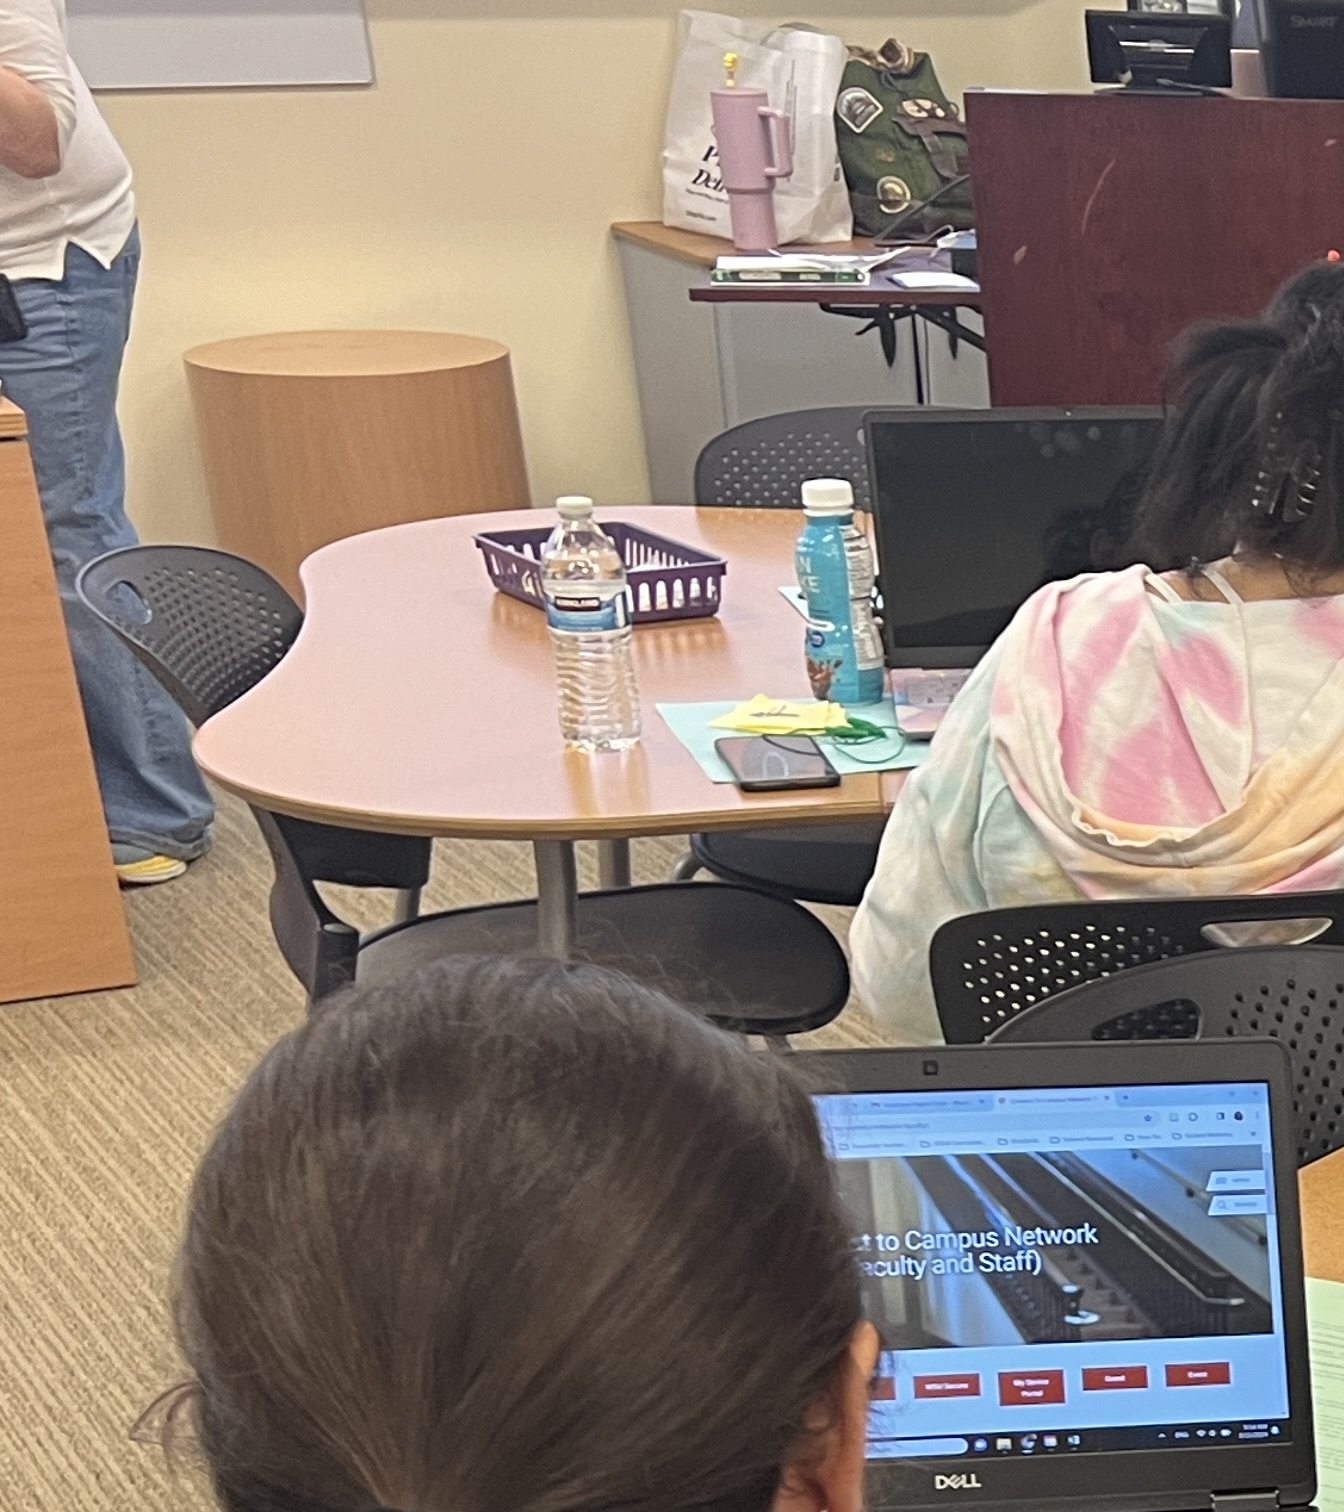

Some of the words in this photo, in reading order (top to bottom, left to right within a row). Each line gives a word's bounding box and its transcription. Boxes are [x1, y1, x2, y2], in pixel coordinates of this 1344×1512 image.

[877, 1231, 900, 1251] to
[904, 1229, 999, 1254] Campus
[1005, 1222, 1099, 1248] Network
[860, 1256, 924, 1281] aculty
[931, 1254, 973, 1275] and
[979, 1251, 1043, 1276] Staff)
[934, 1474, 982, 1490] DELL
